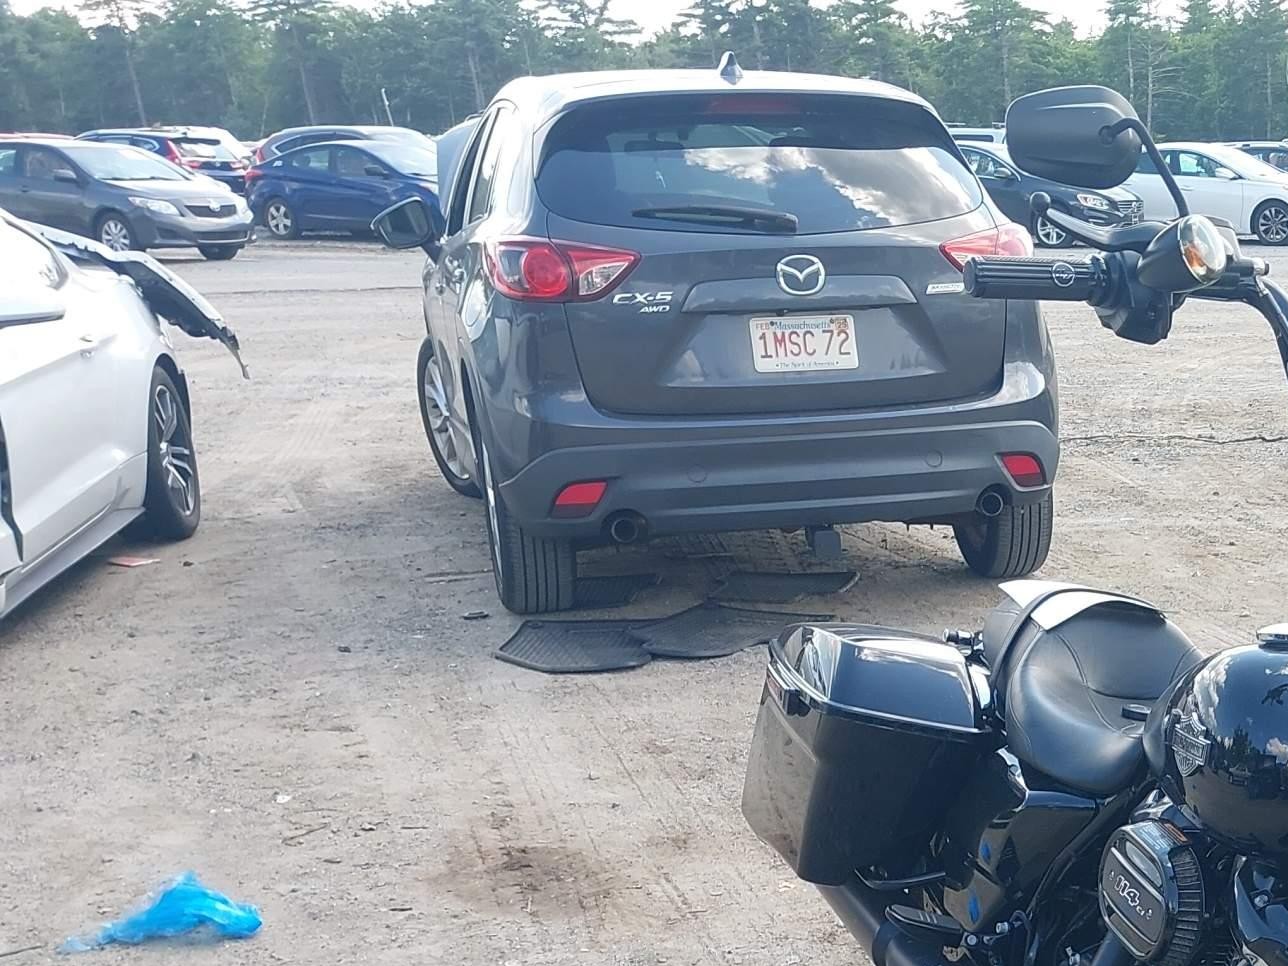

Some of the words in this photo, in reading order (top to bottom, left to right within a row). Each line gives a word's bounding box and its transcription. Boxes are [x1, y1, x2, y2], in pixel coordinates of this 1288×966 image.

[613, 291, 673, 304] CX-5
[640, 305, 670, 313] AWD
[774, 320, 831, 330] Massachusetts
[758, 330, 816, 359] 1MSC
[822, 329, 851, 356] 72
